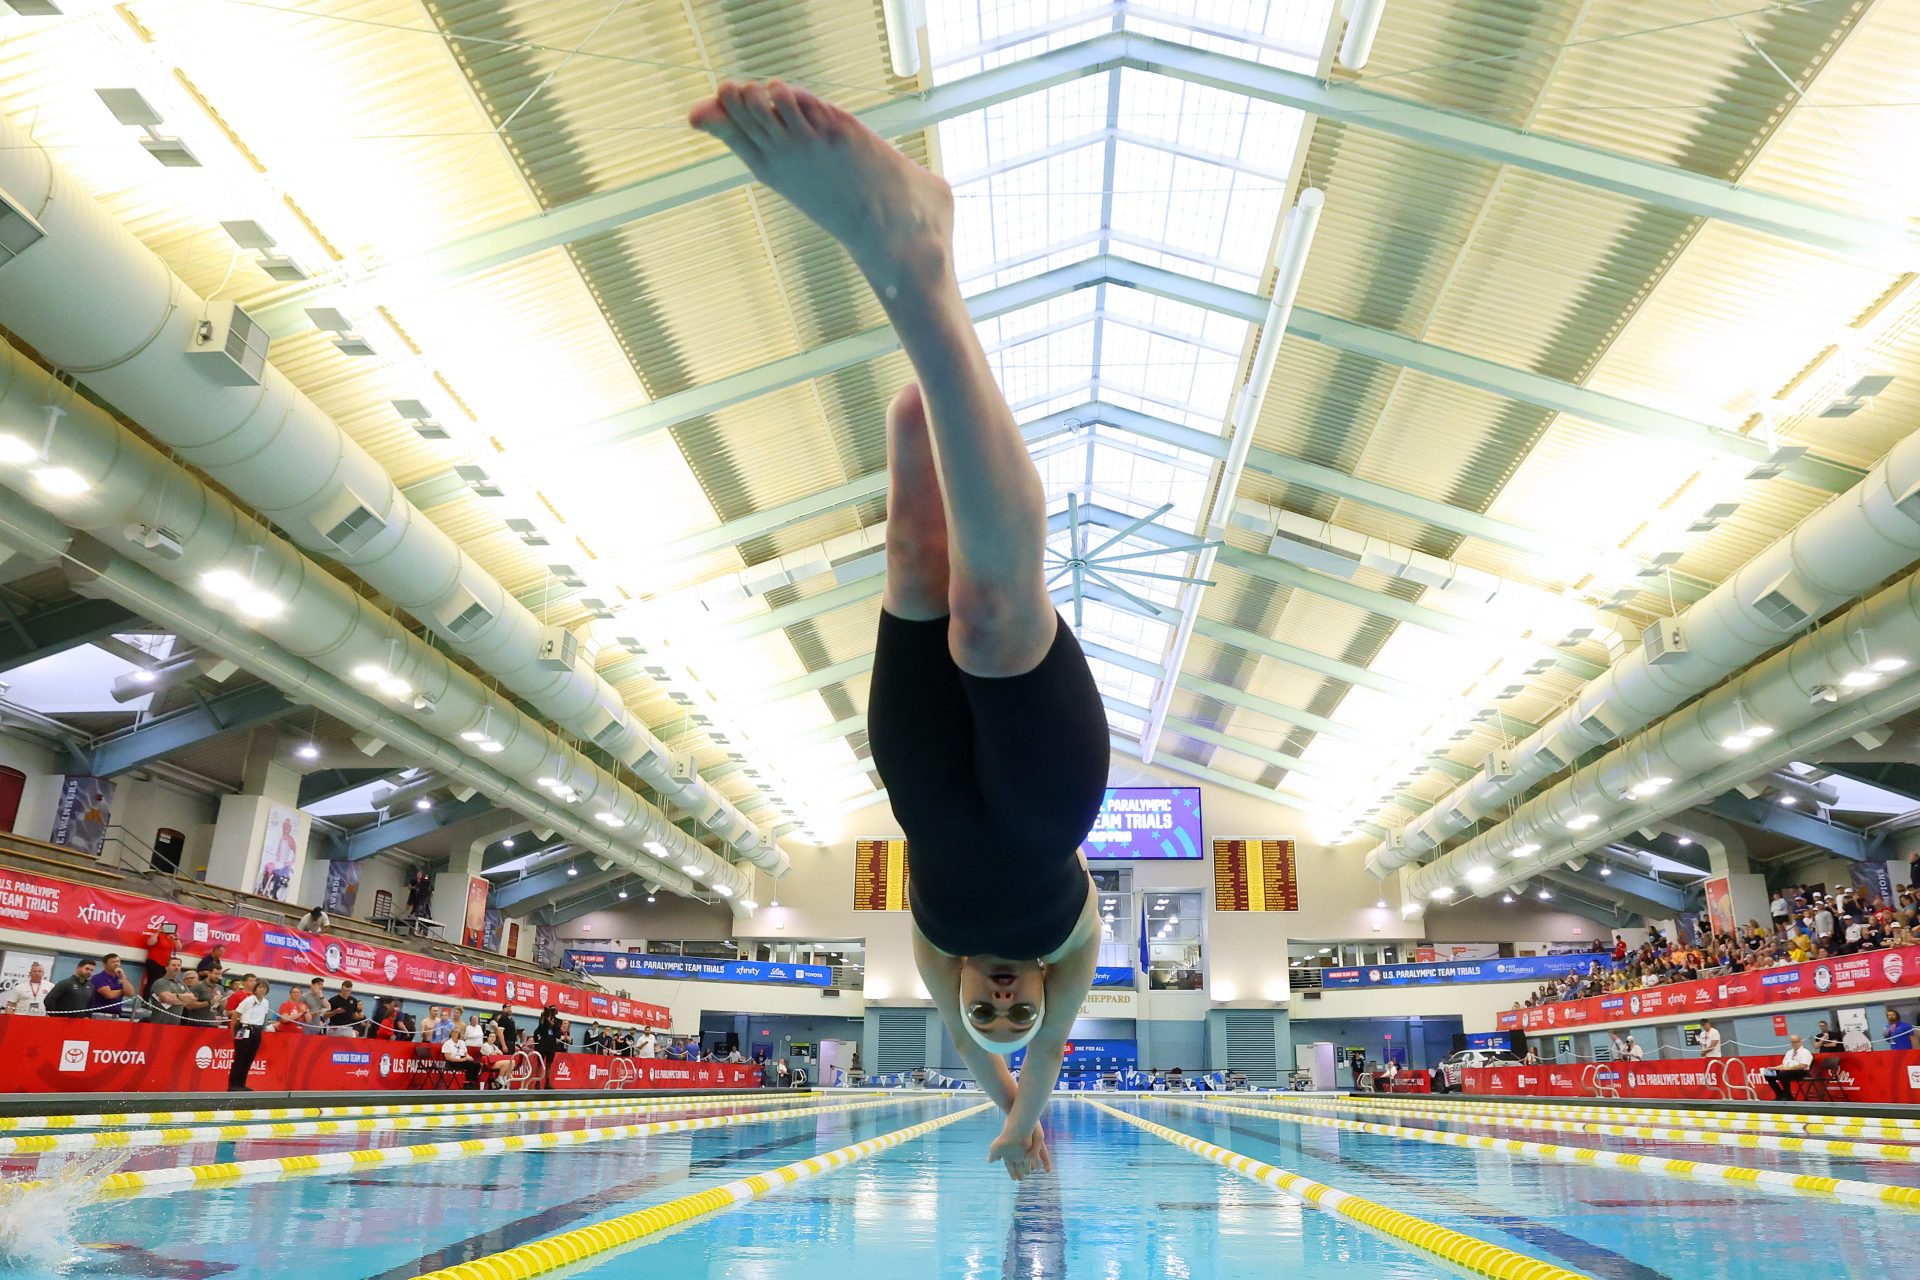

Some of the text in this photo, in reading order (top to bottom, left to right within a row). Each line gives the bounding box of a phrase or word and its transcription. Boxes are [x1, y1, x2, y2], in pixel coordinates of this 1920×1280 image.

[1107, 799, 1172, 812] PARALYMPIC
[1093, 814, 1173, 829] EAM TRIALS
[14, 881, 60, 899] PARALYMPIC
[26, 896, 58, 914] TRIALS
[77, 903, 126, 929] xfinity
[210, 930, 240, 943] TOYOTA
[264, 934, 286, 946] MAKING
[345, 956, 374, 970] TEAM TRIALS
[630, 960, 725, 974] U.S. PARALYMPIC TEAM TRIALS
[736, 966, 760, 976] xfinity
[1383, 966, 1481, 980] U.S. PARALYMPIC TEAM TRIALS
[1835, 968, 1871, 981] TEAM TRIALS
[1667, 993, 1687, 1006] xfinity
[92, 1049, 146, 1065] TOYOTA
[214, 1048, 235, 1059] VISIT
[349, 1054, 361, 1062] TEAM
[361, 1054, 370, 1063] USA
[392, 1058, 405, 1073] U.S.
[1636, 1074, 1646, 1086] U.S.
[1646, 1073, 1680, 1086] PARALYMPIC
[1680, 1073, 1695, 1086] TEAM
